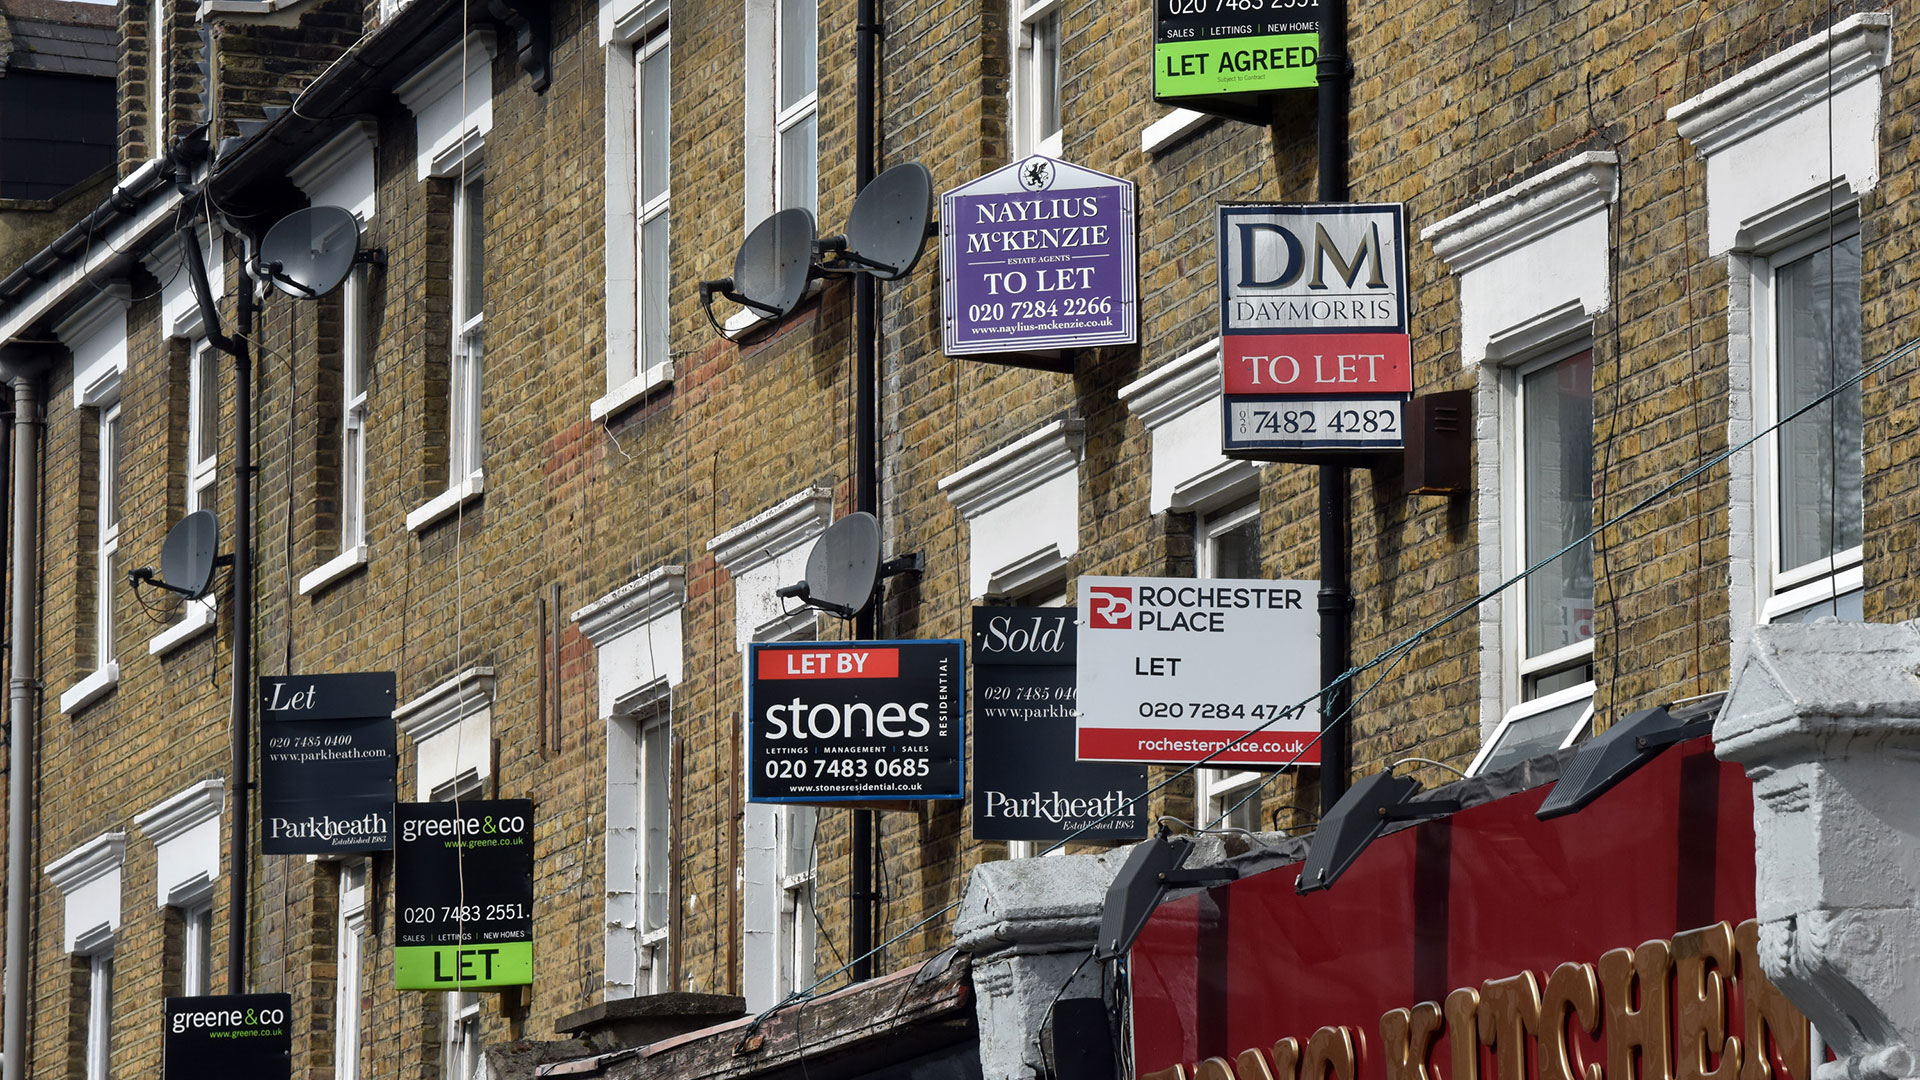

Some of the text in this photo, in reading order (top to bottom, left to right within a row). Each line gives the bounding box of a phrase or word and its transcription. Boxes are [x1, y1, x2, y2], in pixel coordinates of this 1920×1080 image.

[1167, 21, 1319, 38] SALES LETTINGS NEW HOMES
[1167, 46, 1318, 77] LET AGREED
[976, 196, 1098, 225] NAYLIUS
[1008, 254, 1070, 265] ESTATE AGENTS
[1236, 220, 1389, 291] DM
[984, 267, 1095, 295] TO LET
[968, 296, 1112, 322] 020 7284 2266
[1236, 300, 1390, 321] DAYMORRIS
[972, 317, 1112, 335] www.naylius-mckenzie.co.uk
[1242, 354, 1384, 384] TO LET
[1254, 410, 1316, 434] 7482
[1327, 410, 1396, 433] 4282
[1139, 586, 1303, 610] ROCHESTER
[1139, 612, 1224, 632] PLACE
[982, 616, 1066, 653] Sold
[787, 652, 869, 674] LET BY
[1136, 657, 1182, 676] LET
[266, 682, 316, 712] Let
[939, 657, 948, 736] RESIDENTIAL
[984, 687, 1014, 700] 020
[1016, 686, 1049, 700] 7485
[765, 697, 930, 740] stones
[984, 704, 1077, 721] www.parkhe
[1139, 703, 1306, 720] 020 7284 4747
[270, 735, 352, 748] 020 7485 0400
[766, 746, 808, 754] LETTINGS
[824, 746, 886, 754] MANAGEMENT
[270, 748, 386, 764] www.parkheath.com
[765, 758, 930, 778] 020 7483 0685
[790, 782, 922, 792] www.stonesresidential.co.uk
[984, 790, 1136, 823] Parkheath
[270, 812, 387, 840] Parkheath
[402, 816, 524, 842] greene&co
[1062, 820, 1113, 830] Estabshed
[444, 836, 524, 849] www.greene.co.uk
[404, 907, 435, 924] 020
[441, 906, 480, 922] 7483
[402, 930, 524, 942] SALES LETTINGS NEW HOMES
[434, 948, 499, 982] LET
[172, 1008, 284, 1033] greene&co
[210, 1028, 283, 1038] www.greene.co.uk
